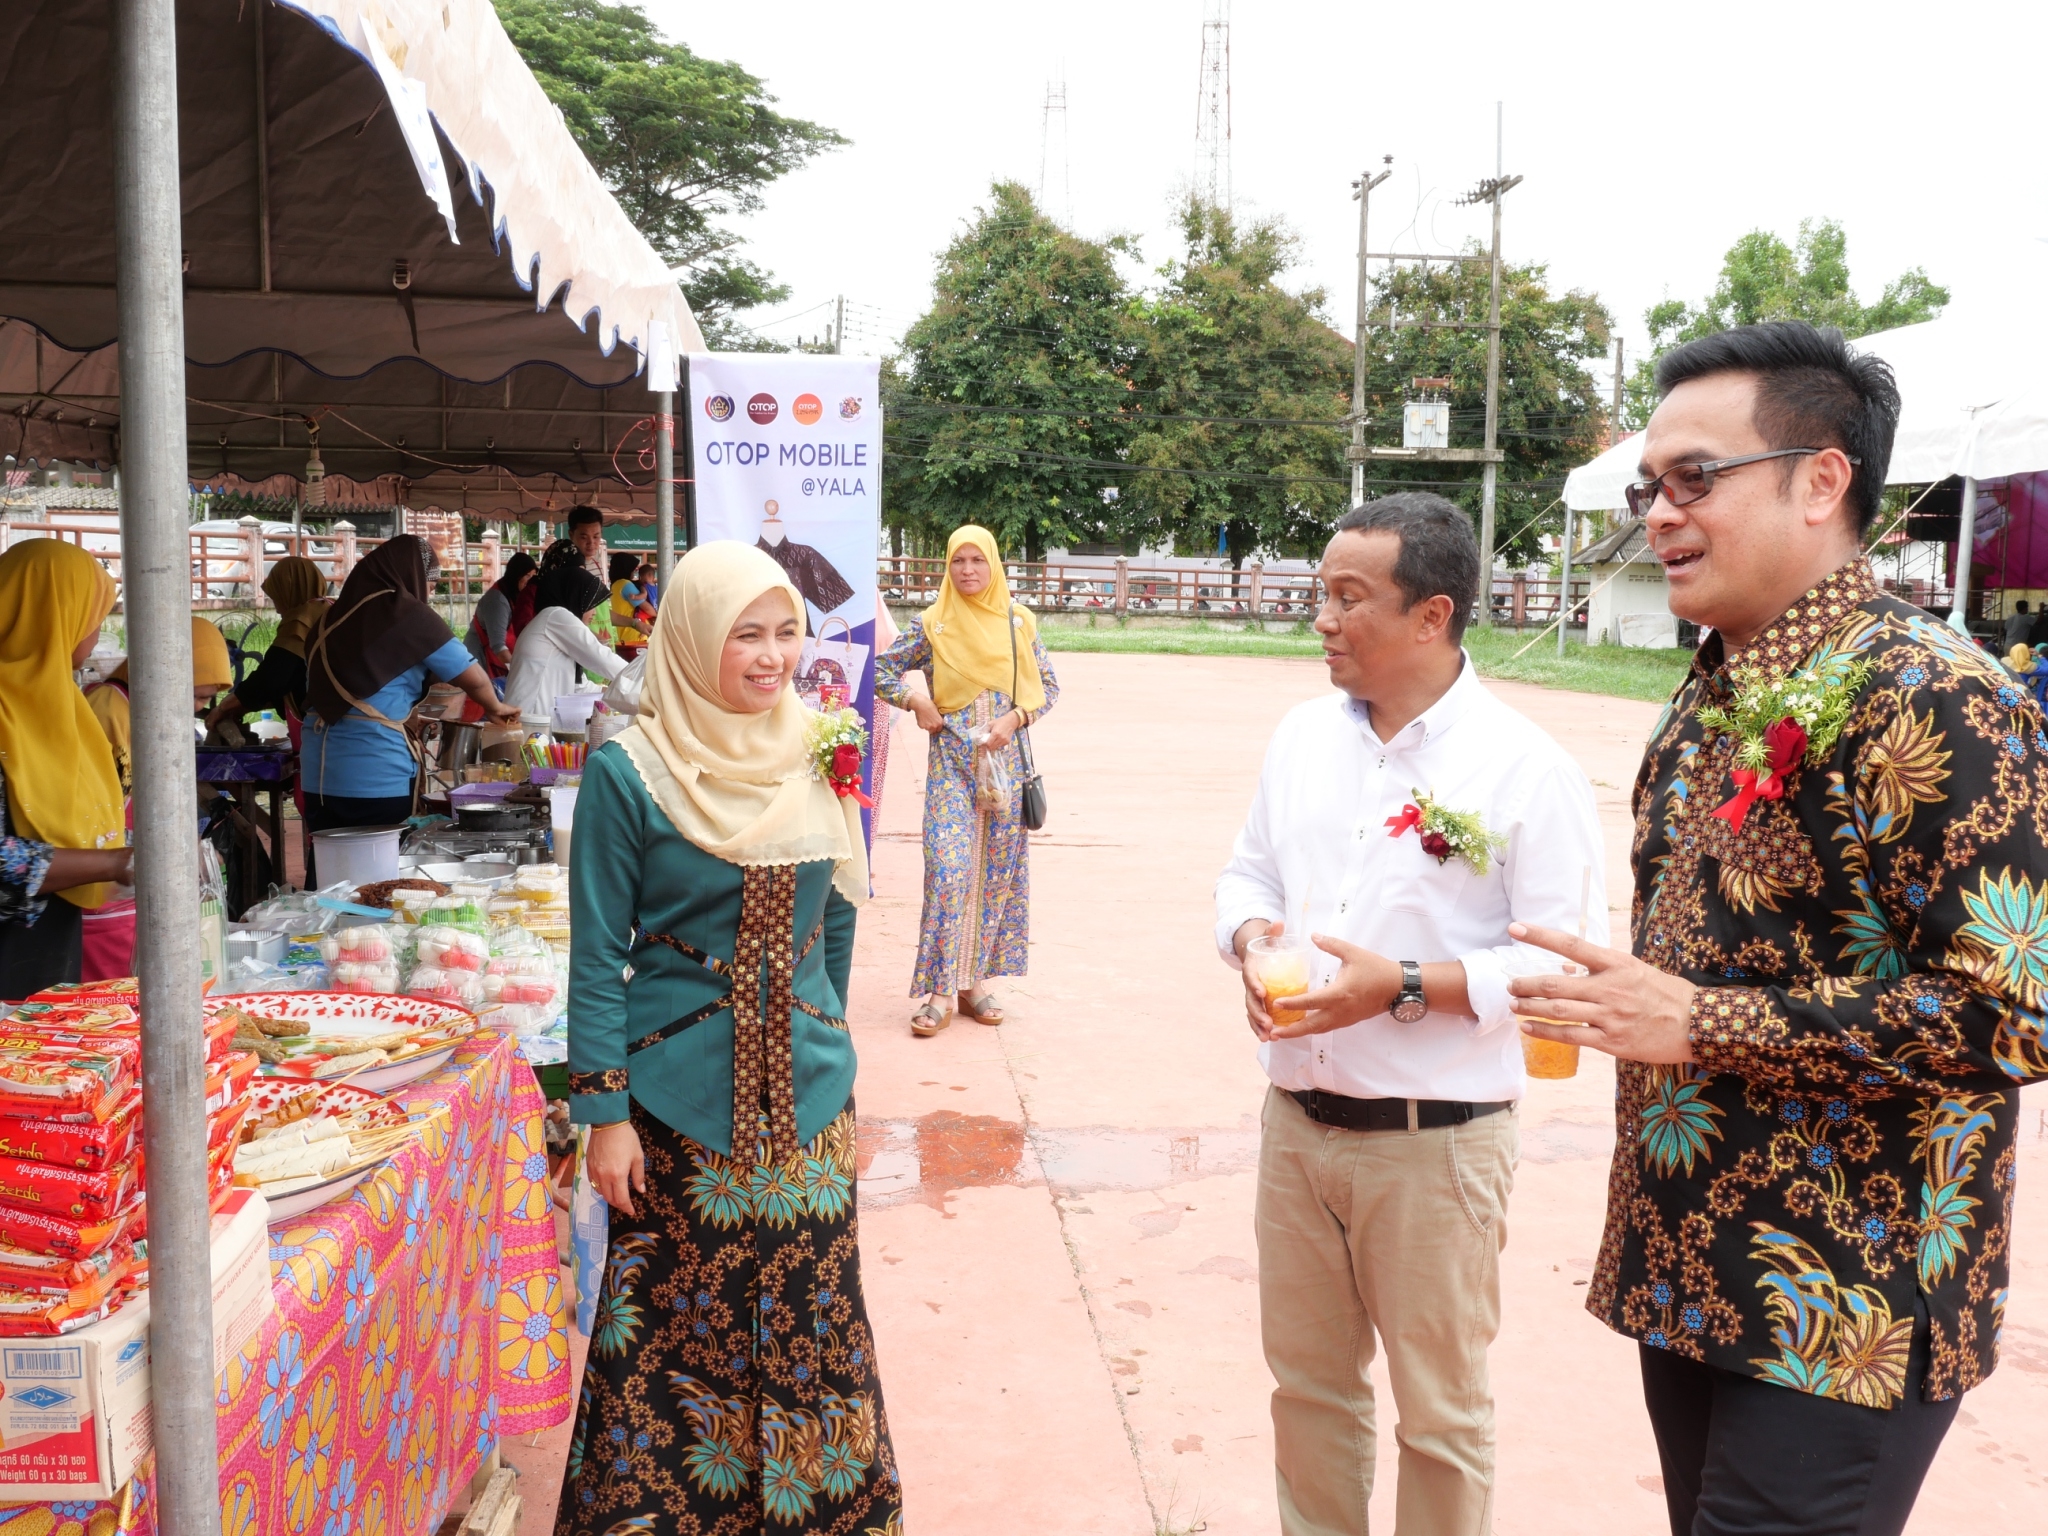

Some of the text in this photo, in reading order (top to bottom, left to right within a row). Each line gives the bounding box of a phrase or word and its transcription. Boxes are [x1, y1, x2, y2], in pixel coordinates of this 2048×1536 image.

[749, 402, 777, 412] OTOP
[706, 441, 867, 467] OTOP MOBILE
[801, 477, 867, 497] @YALA
[20, 1454, 30, 1465] 60
[33, 1453, 48, 1465] กรัม
[51, 1457, 56, 1465] x
[58, 1454, 68, 1465] 30
[29, 1469, 38, 1480] 60
[42, 1472, 47, 1482] g
[57, 1469, 66, 1480] 30
[69, 1469, 87, 1482] bags
